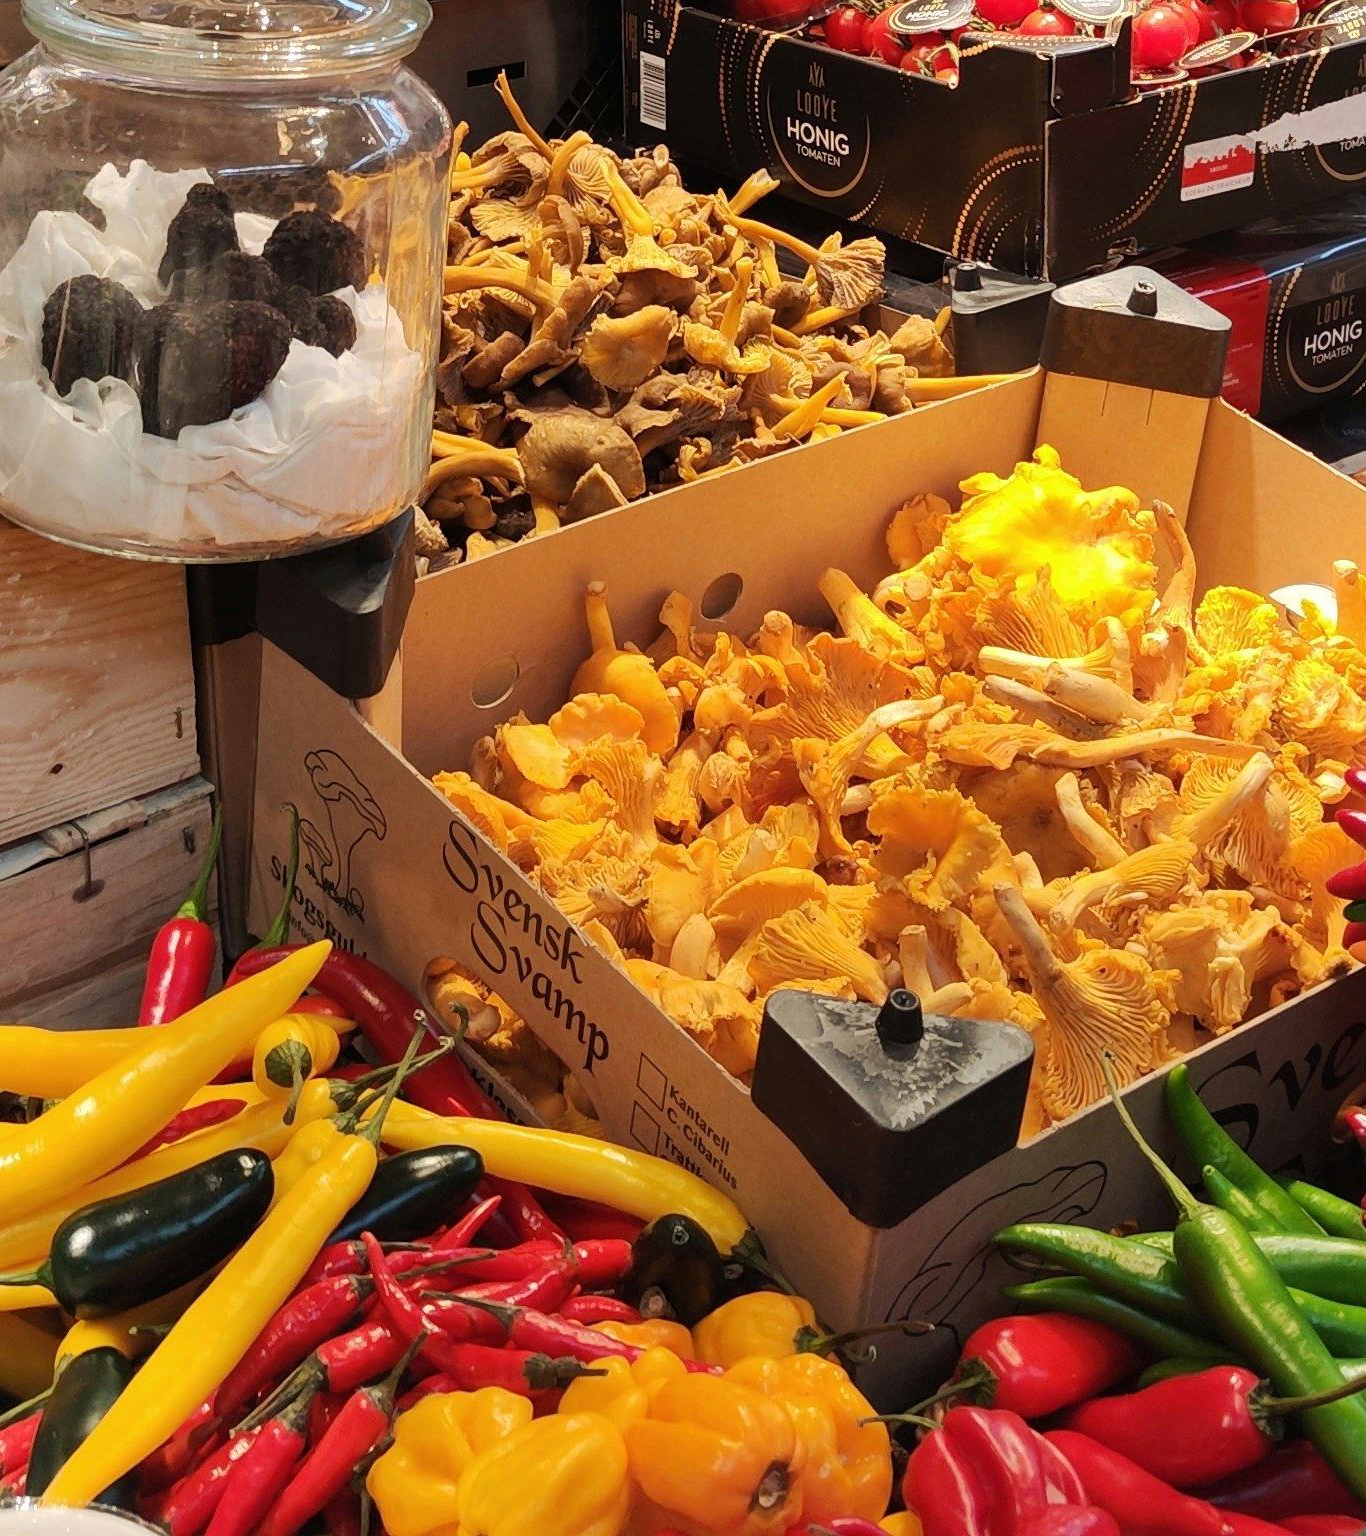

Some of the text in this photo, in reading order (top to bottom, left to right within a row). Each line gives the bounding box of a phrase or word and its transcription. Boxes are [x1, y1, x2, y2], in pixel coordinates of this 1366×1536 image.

[797, 88, 838, 123] LOOYE
[786, 116, 851, 156] HONIG
[796, 142, 841, 168] TOMATEN
[1316, 294, 1355, 326] LOOYE
[1304, 320, 1363, 357] HONIG
[1312, 344, 1354, 367] TOMATEN
[443, 819, 585, 985] Svensk
[470, 900, 610, 1075] Svamp
[669, 1084, 731, 1157] Kantarell
